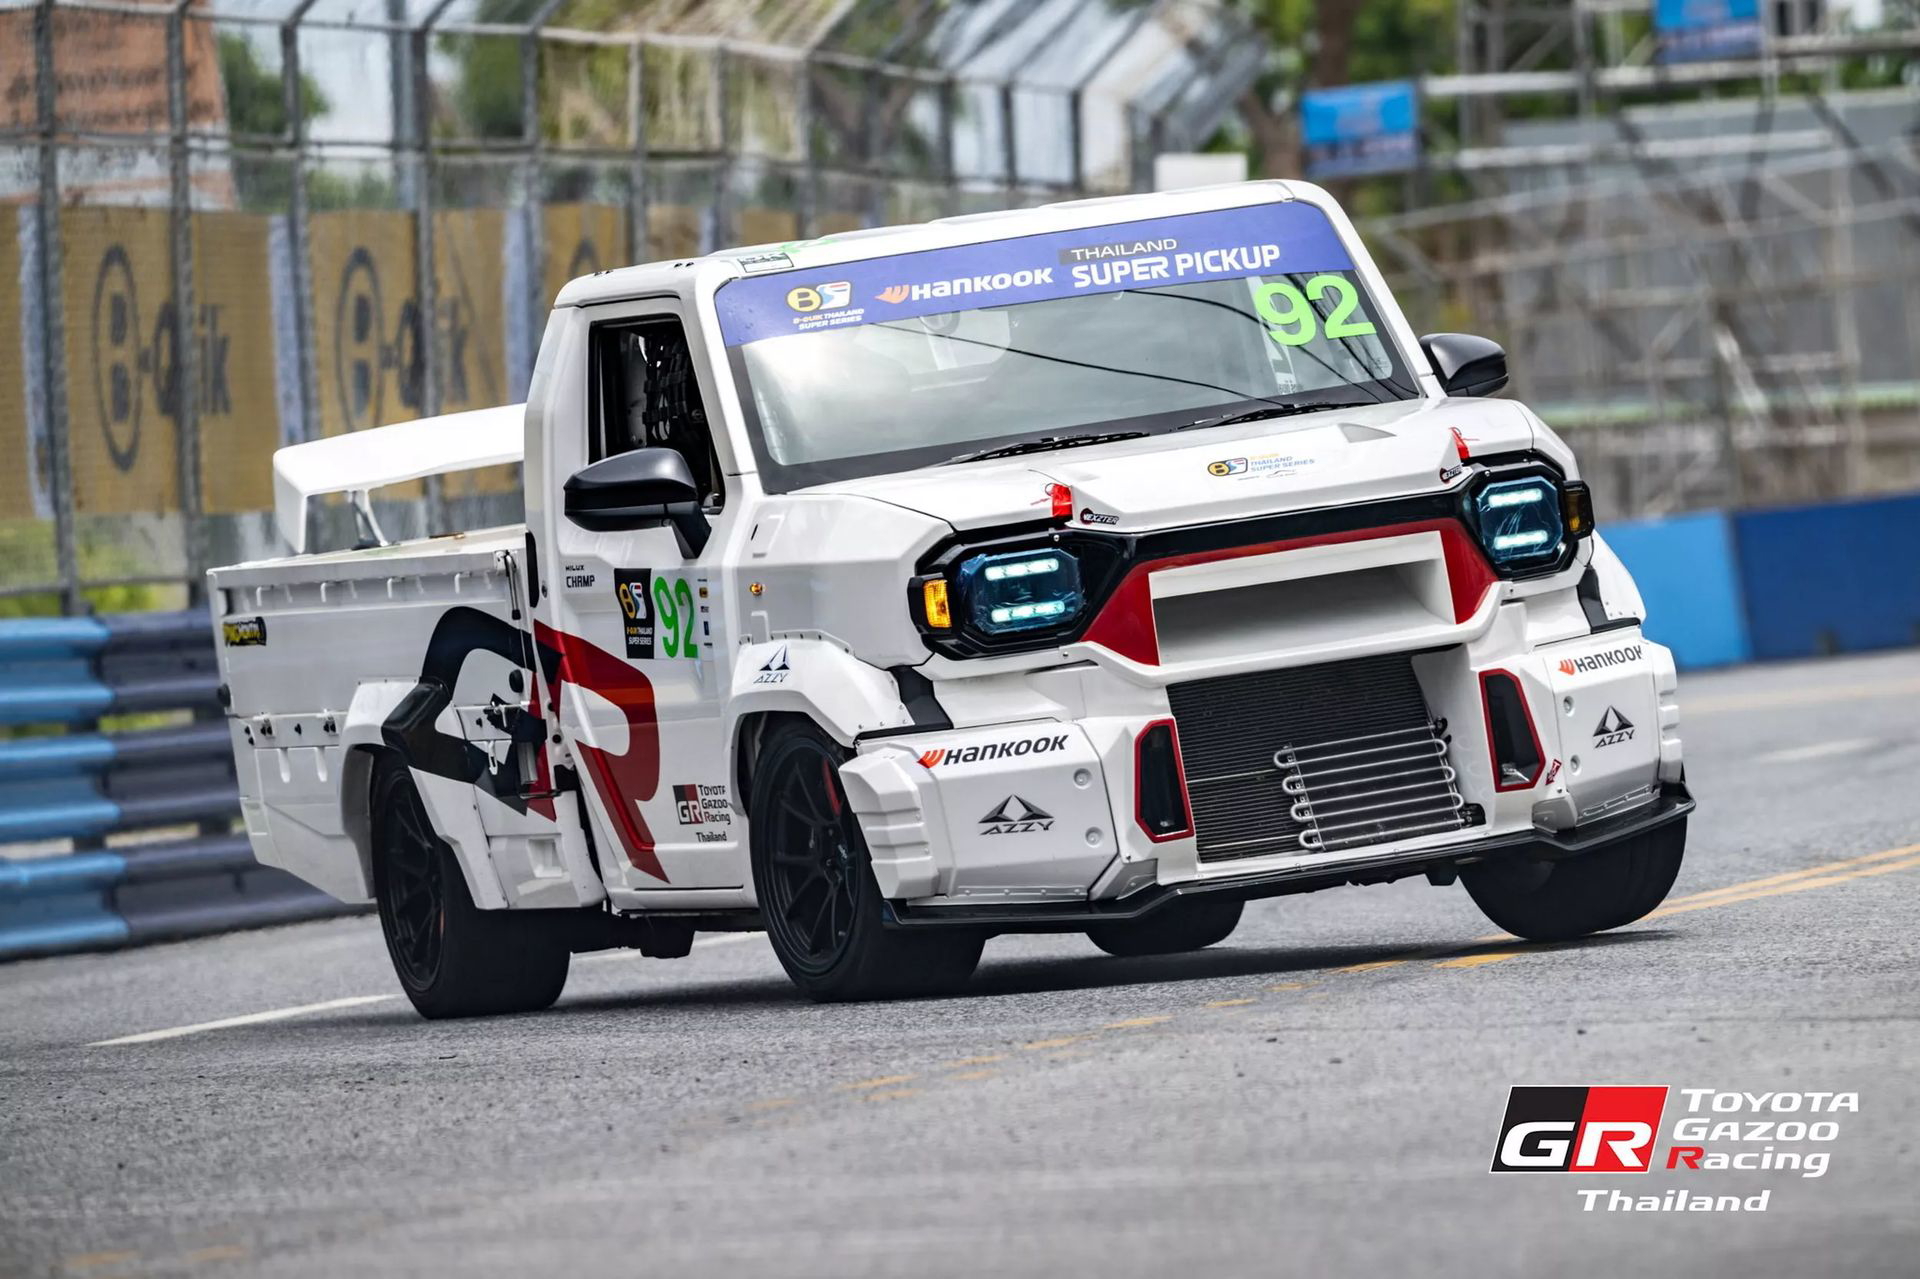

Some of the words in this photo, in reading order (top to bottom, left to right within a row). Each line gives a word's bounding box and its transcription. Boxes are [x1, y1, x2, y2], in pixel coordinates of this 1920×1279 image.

[1071, 238, 1177, 261] THAILAND
[1071, 256, 1171, 289] SUPER
[1175, 244, 1281, 276] PICKUP
[824, 308, 865, 319] THAILAND
[1254, 275, 1377, 346] 92
[799, 319, 829, 330] SUPER
[830, 315, 862, 325] SERIES
[1250, 456, 1293, 466] THAILAND
[1250, 462, 1281, 473] SUPER
[1282, 458, 1315, 469] SERIES
[566, 574, 596, 589] CHAMP
[654, 576, 698, 658] 92
[753, 672, 789, 684] AZZY
[1594, 729, 1636, 749] AZZY
[677, 800, 703, 823] GR
[701, 798, 729, 810] GAZOO
[704, 810, 732, 825] Racing
[979, 820, 1055, 836] AZZY
[695, 831, 728, 842] Thailand
